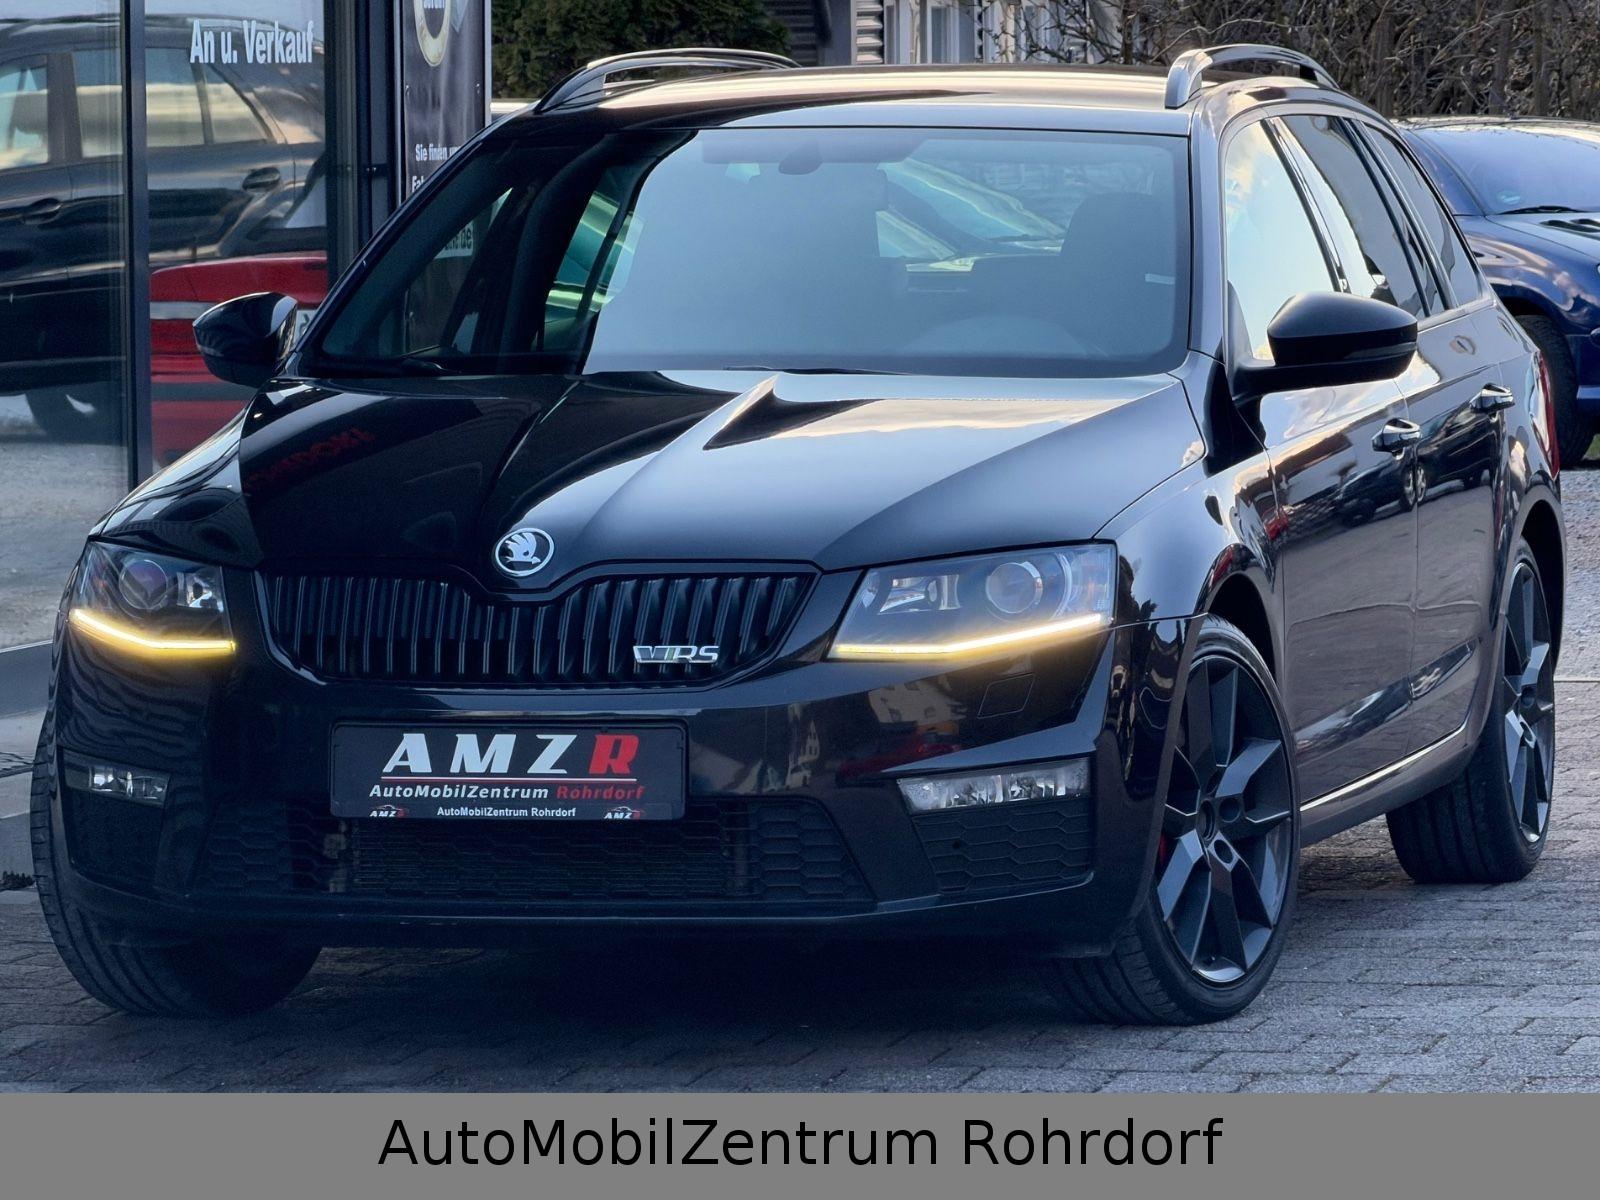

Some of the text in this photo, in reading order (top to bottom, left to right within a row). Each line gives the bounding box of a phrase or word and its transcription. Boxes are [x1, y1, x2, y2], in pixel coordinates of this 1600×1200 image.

[189, 19, 314, 64] An u. Verkauf
[415, 143, 428, 161] Sie
[369, 784, 646, 800] AutoMobilZentrum Rohrdorf
[437, 806, 577, 817] AutoMobilZentrum Rohrdorf
